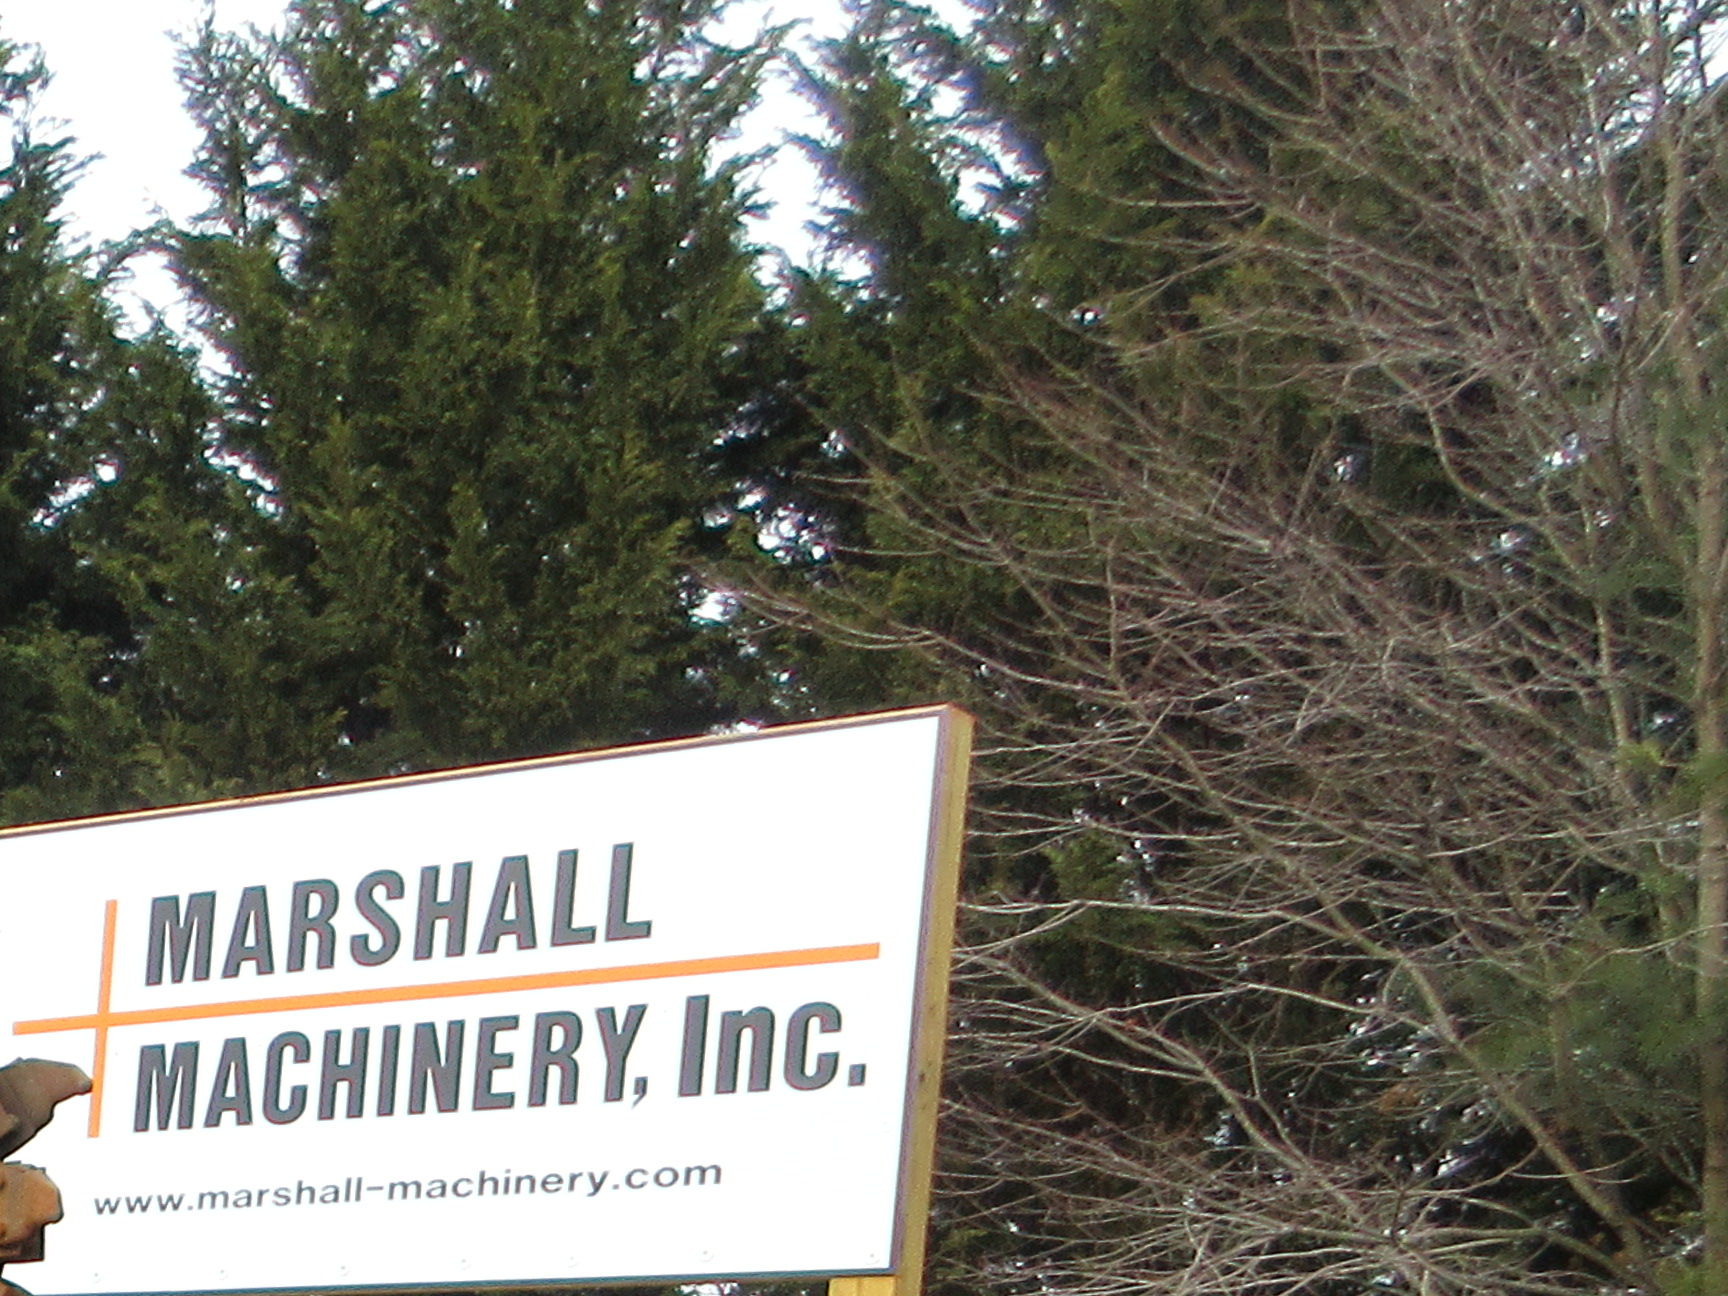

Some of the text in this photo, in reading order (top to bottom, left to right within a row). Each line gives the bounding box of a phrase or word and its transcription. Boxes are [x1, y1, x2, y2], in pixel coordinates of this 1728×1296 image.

[144, 841, 653, 987] MARSHALL
[133, 993, 867, 1133] MACHINERY, Inc.
[92, 1162, 724, 1216] www.marshall-machinery.com
